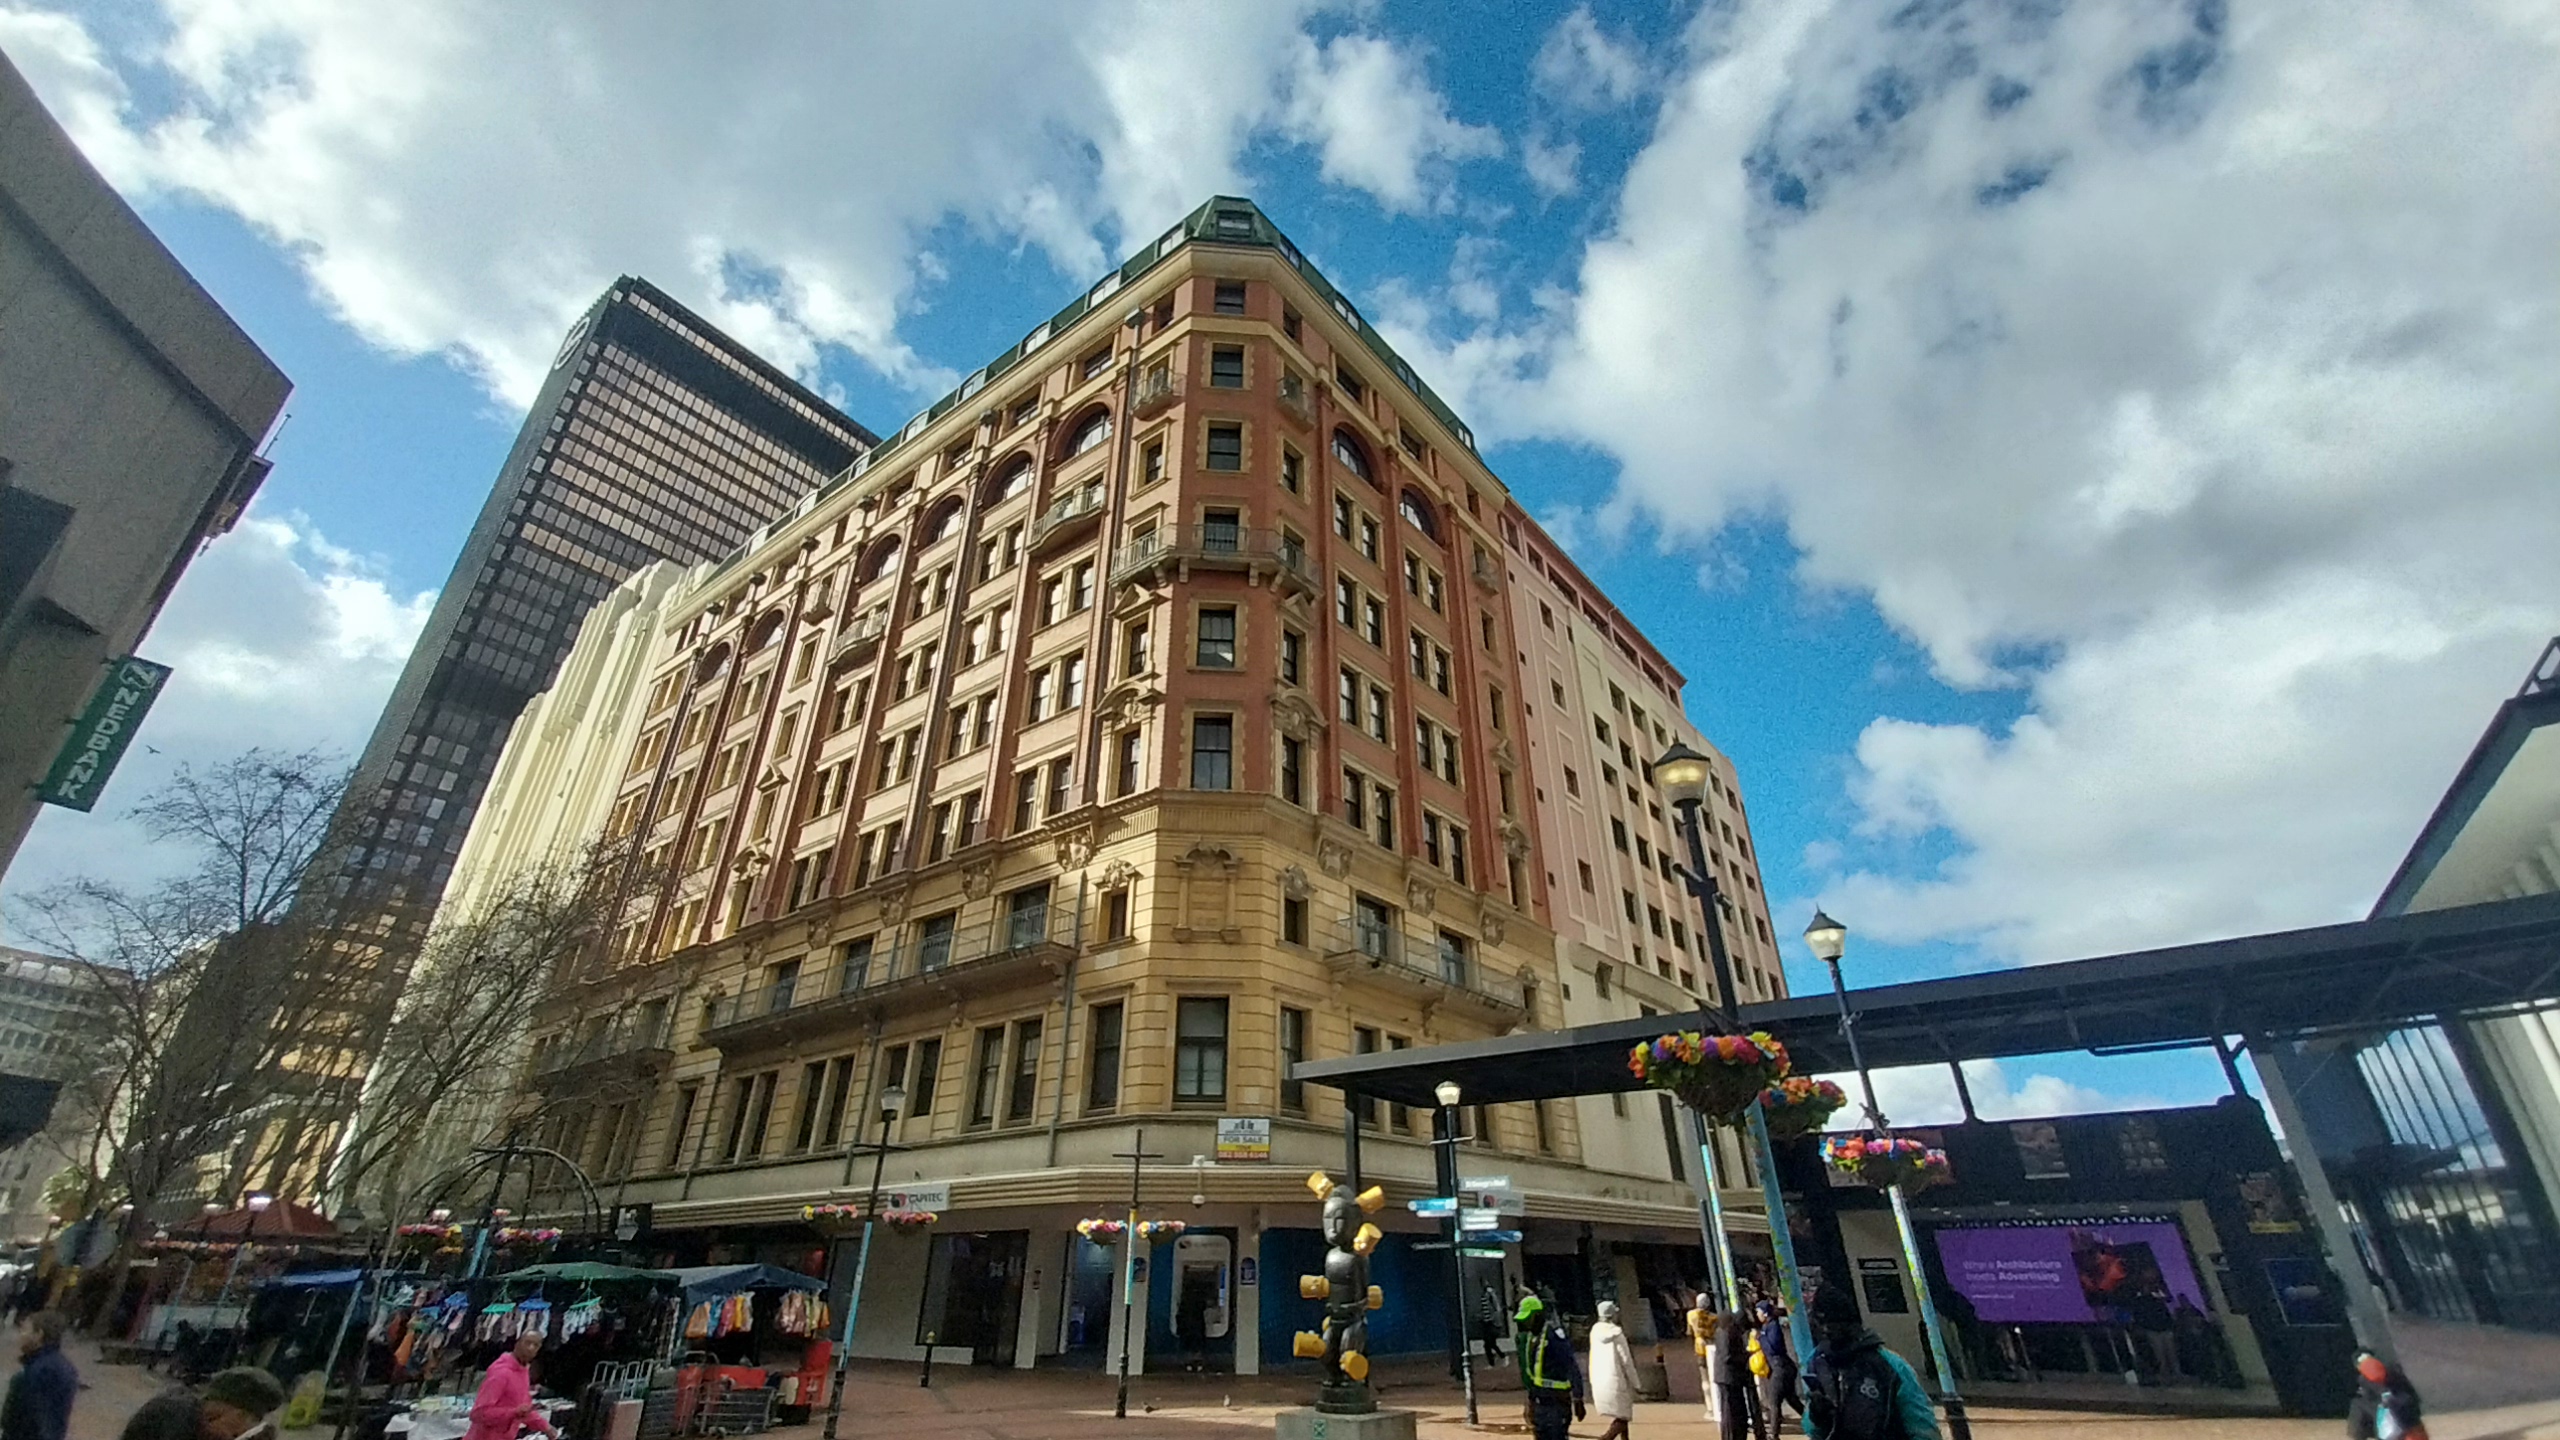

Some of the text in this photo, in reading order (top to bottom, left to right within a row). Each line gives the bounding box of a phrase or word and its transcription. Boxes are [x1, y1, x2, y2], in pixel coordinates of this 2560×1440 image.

[57, 686, 140, 800] NEDBANK
[1224, 1135, 1262, 1143] FOR SALE
[1998, 1271, 2060, 1283] Advertising
